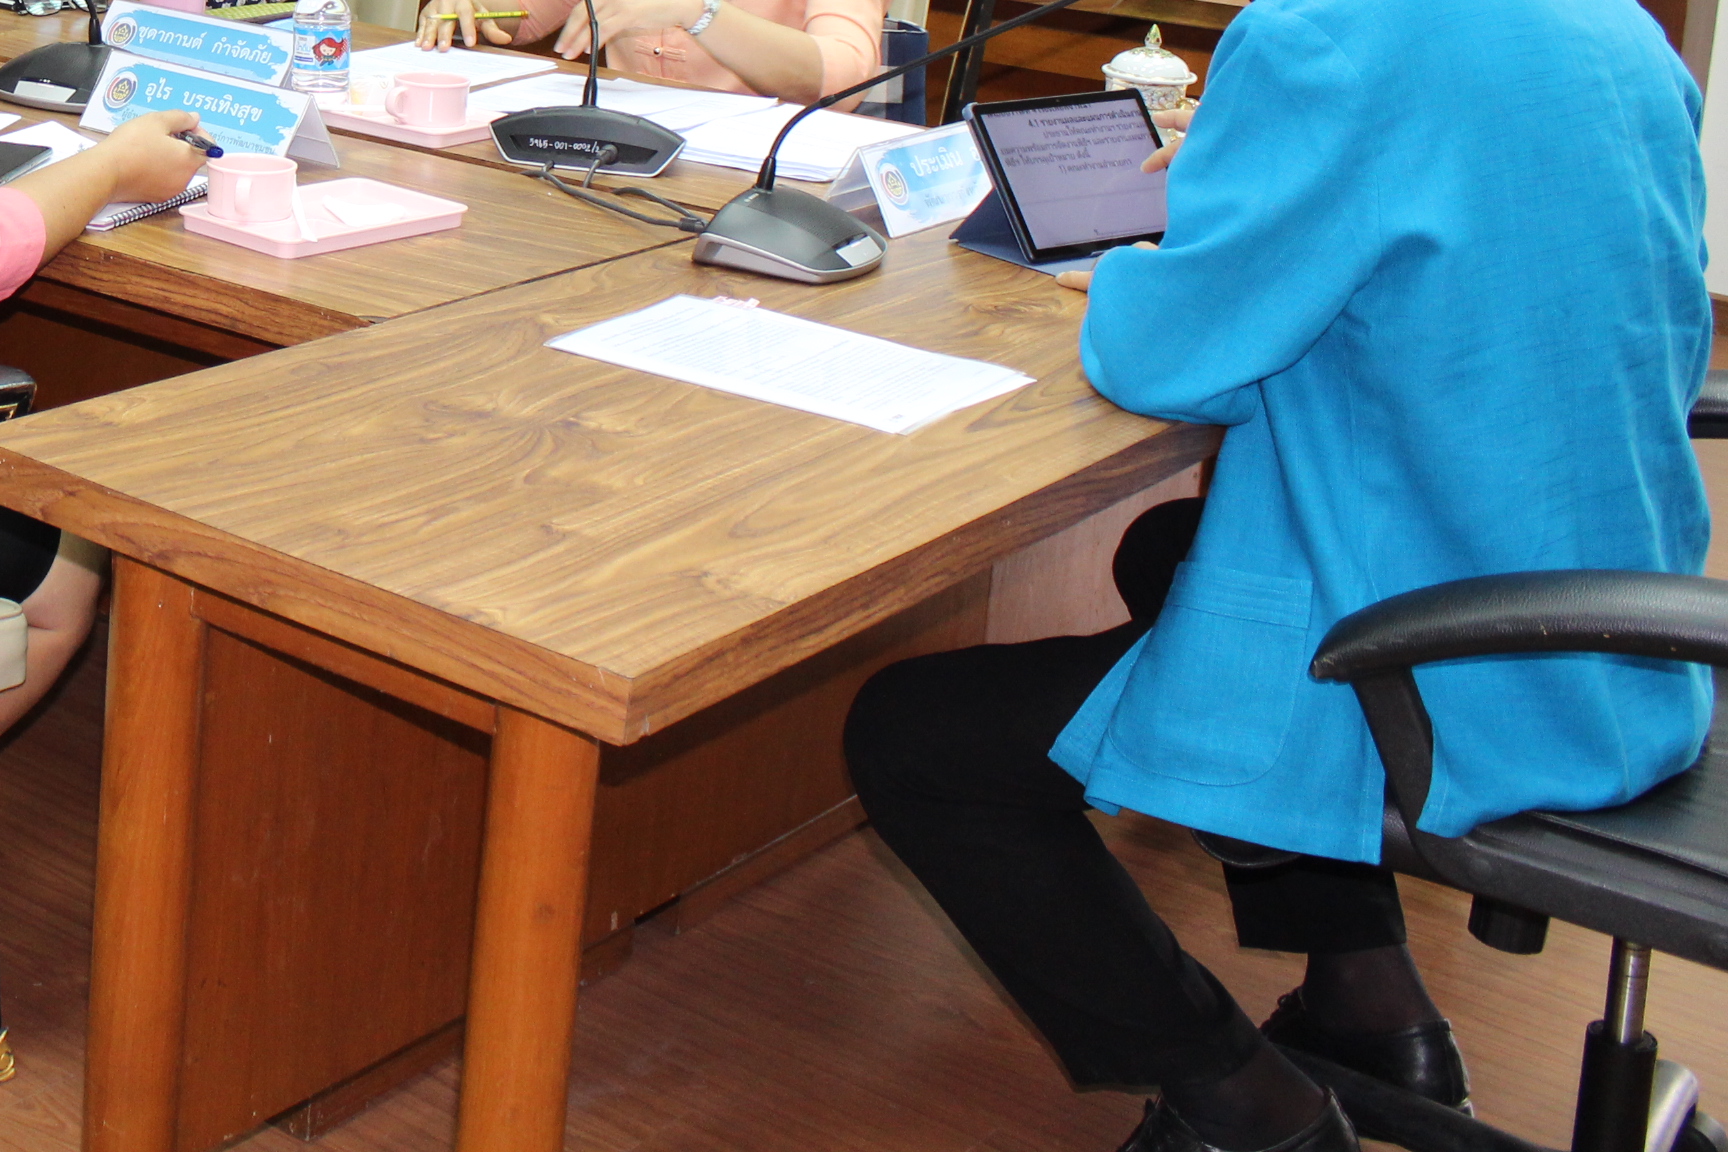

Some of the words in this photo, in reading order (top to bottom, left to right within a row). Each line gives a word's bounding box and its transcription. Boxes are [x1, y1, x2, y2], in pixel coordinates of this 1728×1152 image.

[145, 77, 173, 103] อุไร
[910, 146, 963, 177] ประเมิน
